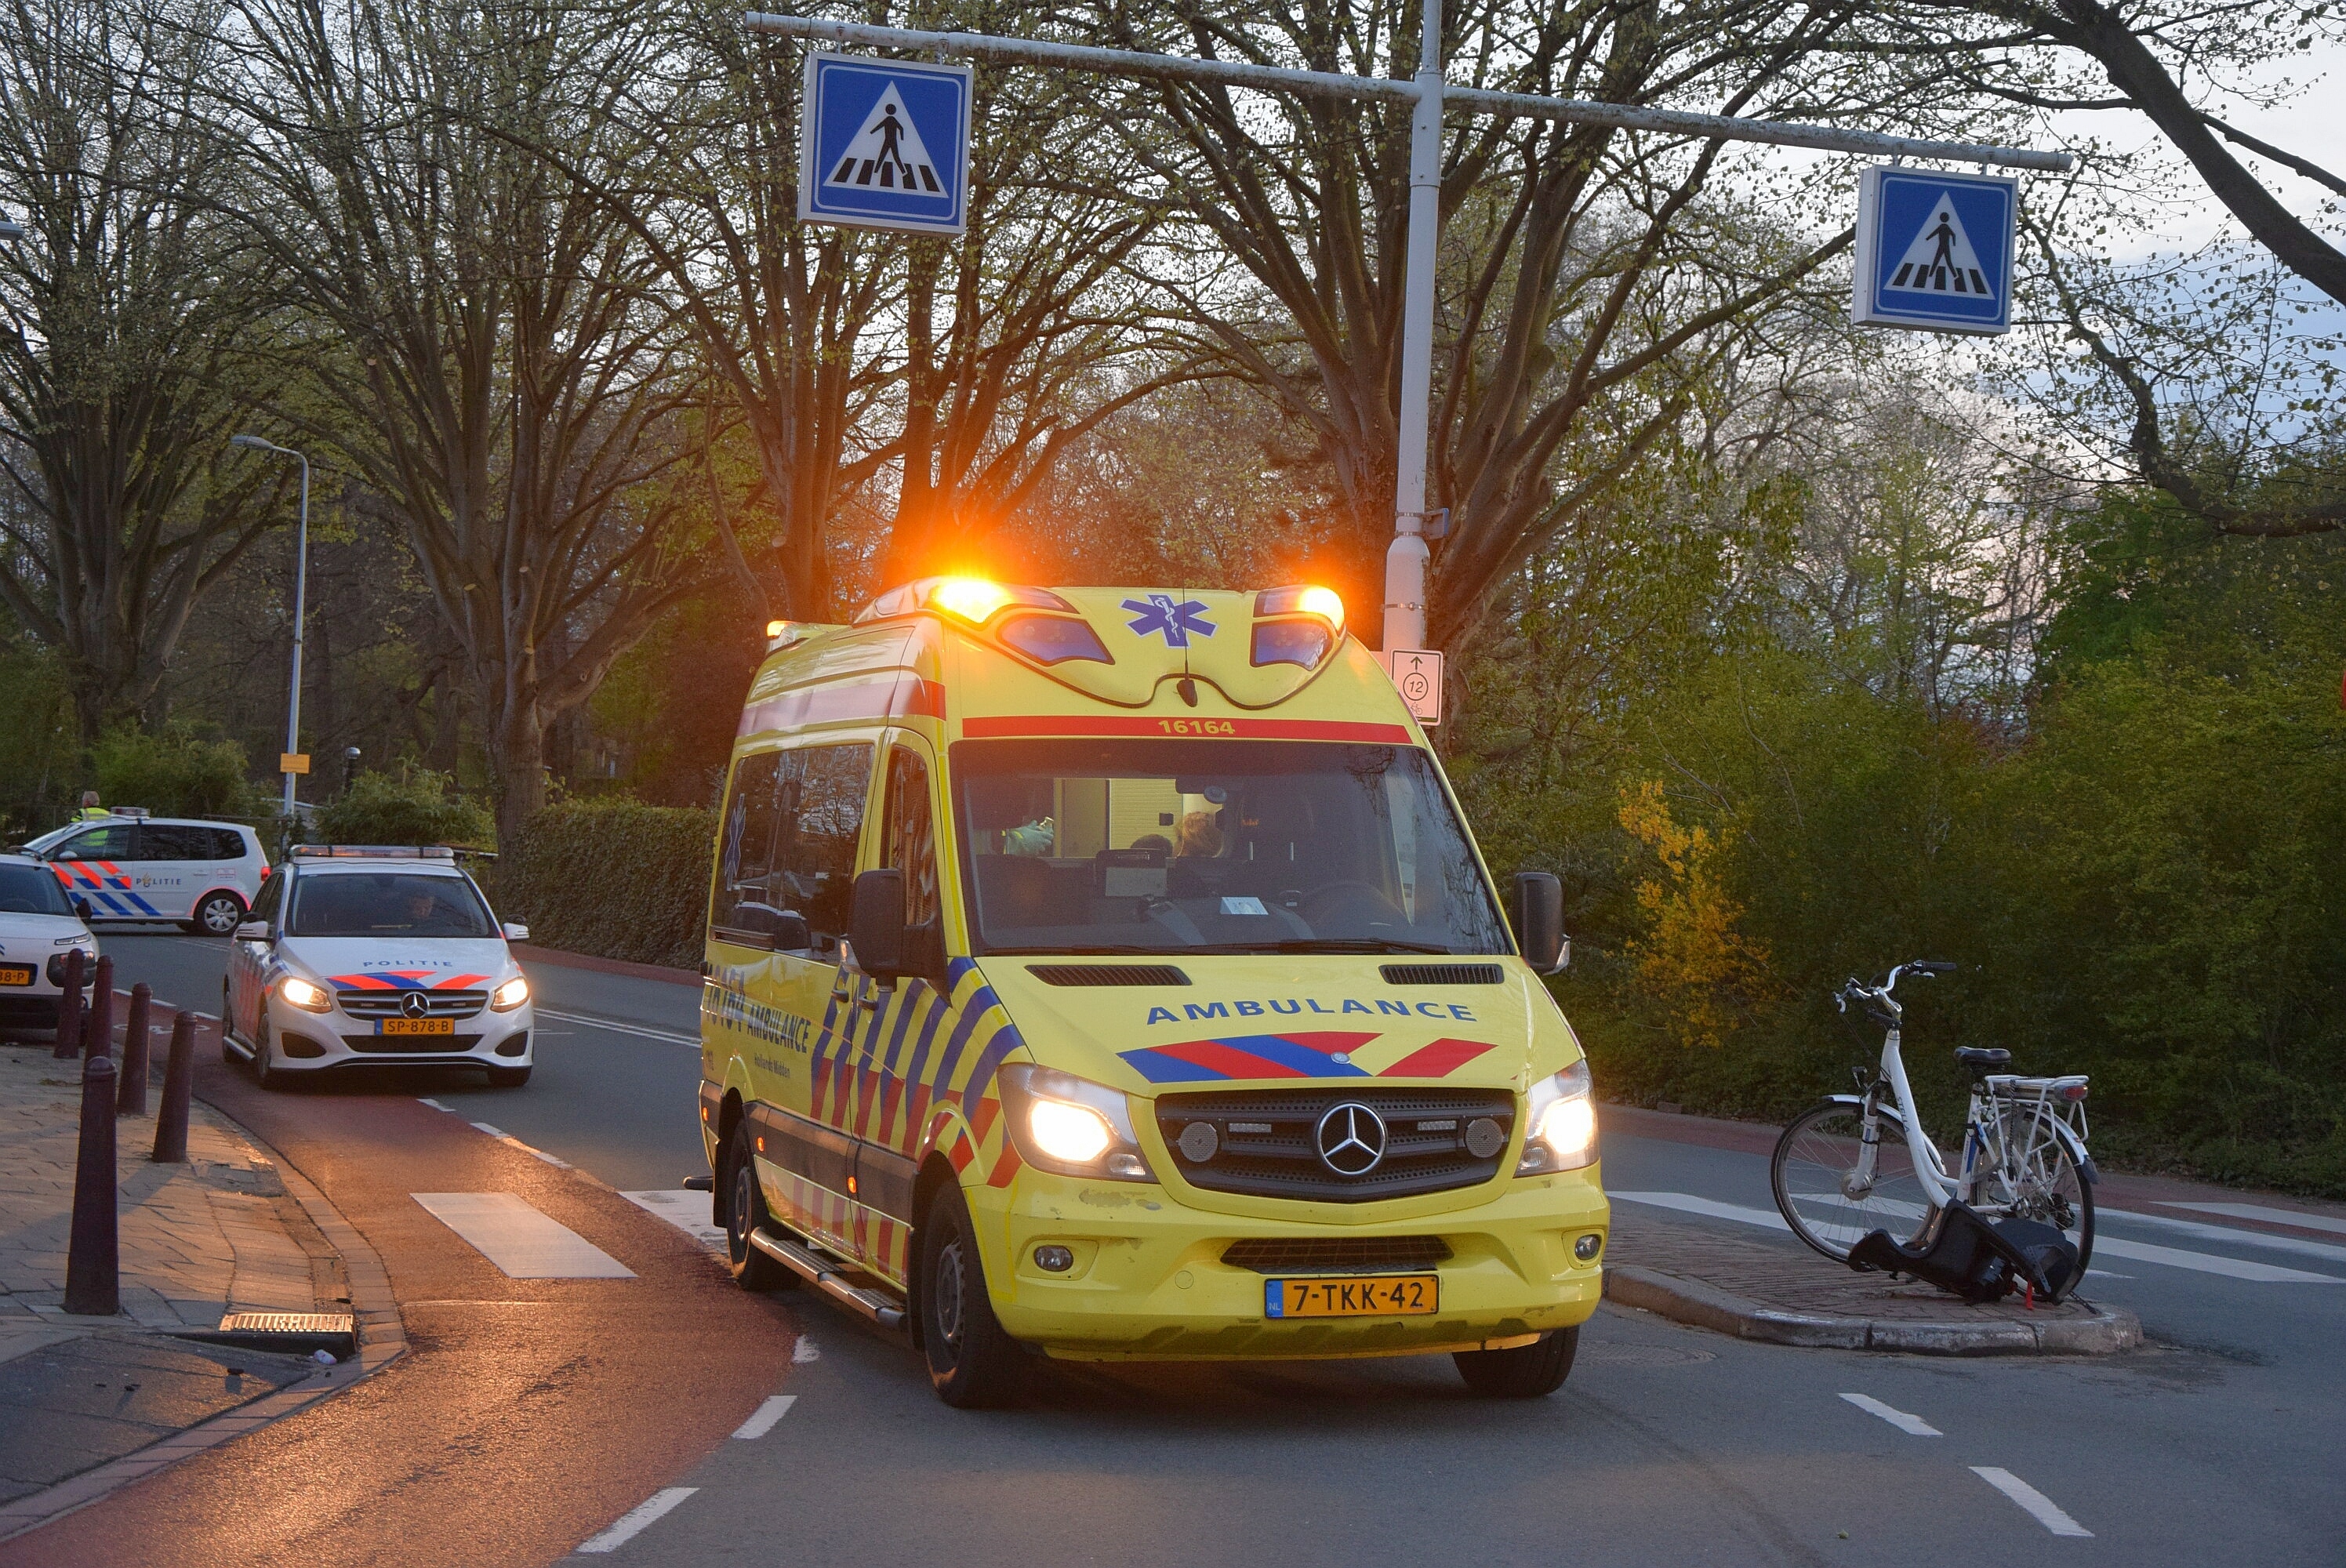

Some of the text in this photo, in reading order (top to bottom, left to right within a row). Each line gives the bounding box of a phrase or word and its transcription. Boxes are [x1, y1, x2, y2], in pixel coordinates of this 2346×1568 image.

[1409, 681, 1424, 693] 12
[1158, 720, 1236, 735] 16164
[1146, 998, 1477, 1025] AMBULANCE
[387, 1021, 448, 1033] SP-878-B
[747, 1004, 812, 1054] AMBULANCE
[1898, 1096, 1910, 1133] STELLA
[1269, 1302, 1280, 1311] NL
[1293, 1282, 1424, 1312] 7-TKK-42
